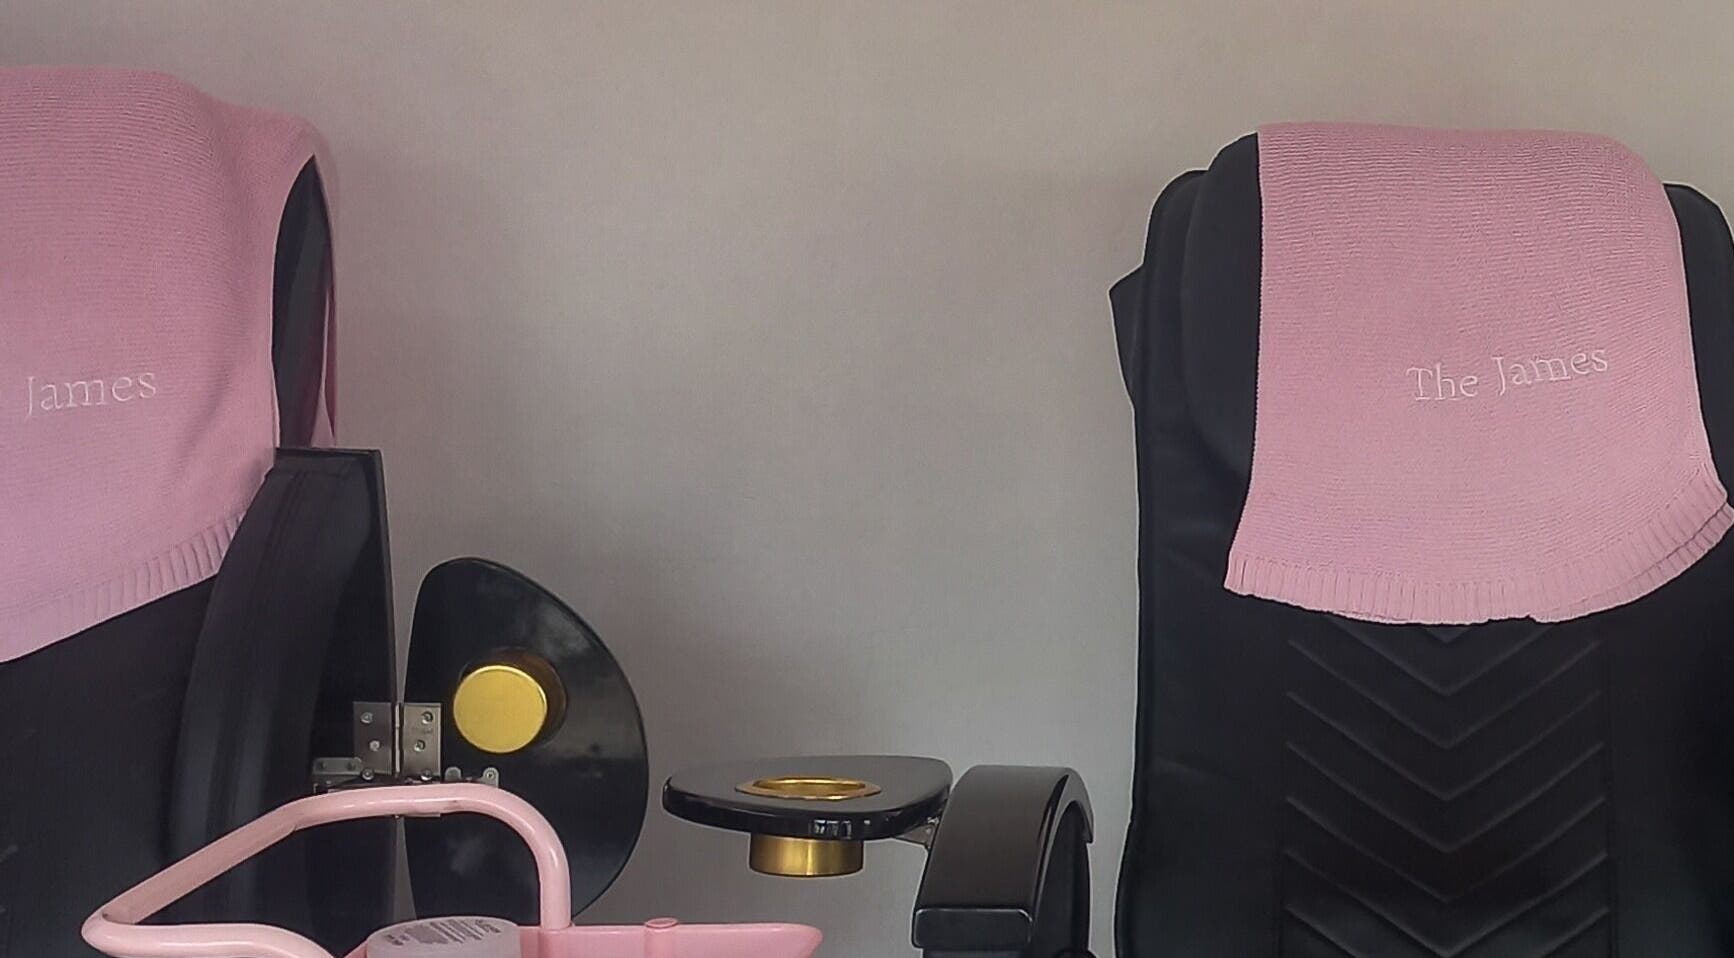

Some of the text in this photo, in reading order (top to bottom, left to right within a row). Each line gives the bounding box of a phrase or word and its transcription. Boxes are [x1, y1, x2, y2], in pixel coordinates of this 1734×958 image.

[27, 371, 157, 417] James
[1406, 349, 1608, 401] The James
